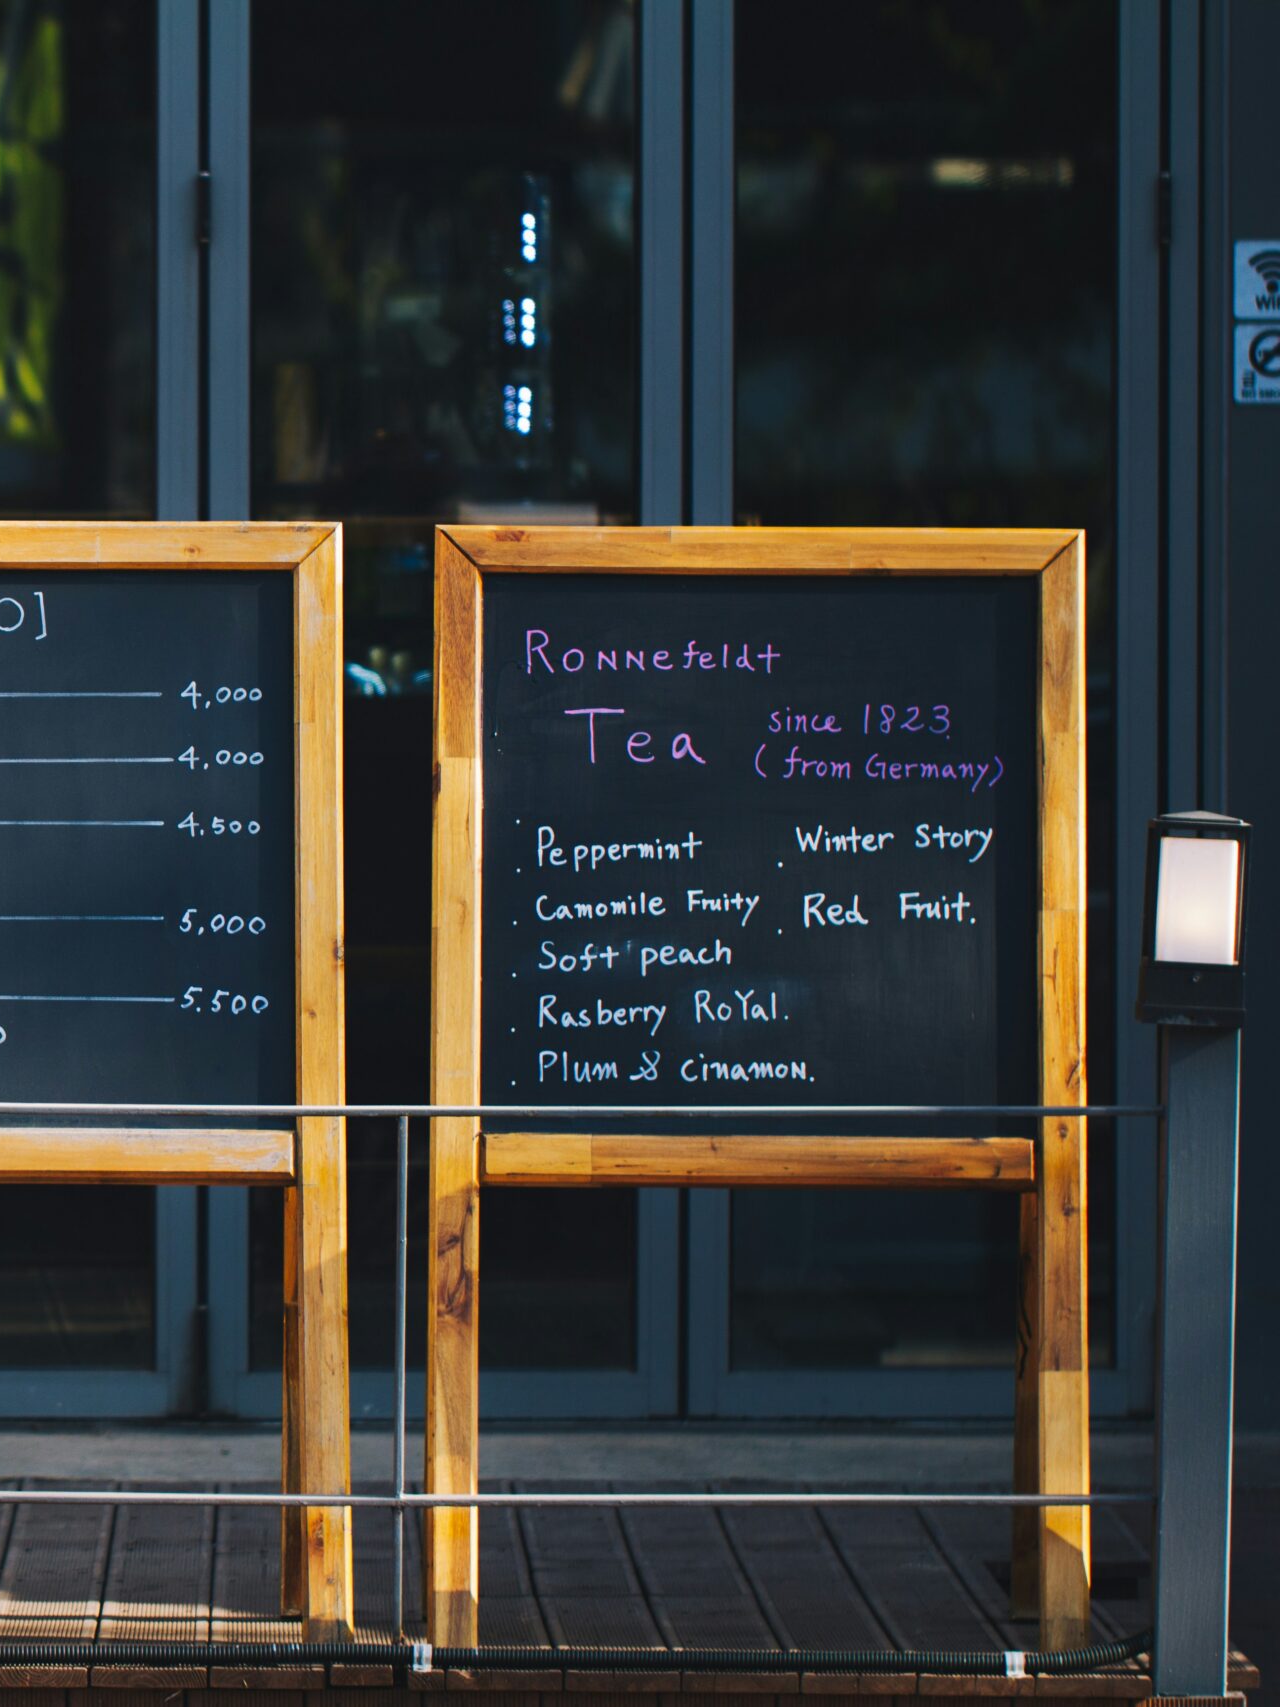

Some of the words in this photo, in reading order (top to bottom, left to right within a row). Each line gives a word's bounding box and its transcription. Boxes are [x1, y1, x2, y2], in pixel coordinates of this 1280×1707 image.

[181, 681, 262, 709] 4,000
[564, 708, 706, 764] Tea
[768, 707, 841, 733] since
[178, 746, 264, 770] 4,000
[537, 826, 702, 872] Peppermint
[795, 825, 894, 853] Winter
[915, 824, 993, 863] Story
[179, 909, 266, 935] 5,000
[536, 892, 666, 921] Camomile
[687, 890, 760, 927] Fruity
[803, 893, 868, 928] Red
[538, 941, 619, 972] Soft
[641, 939, 731, 976] peach
[538, 995, 666, 1036] Rasberry
[539, 1050, 618, 1082] Plum
